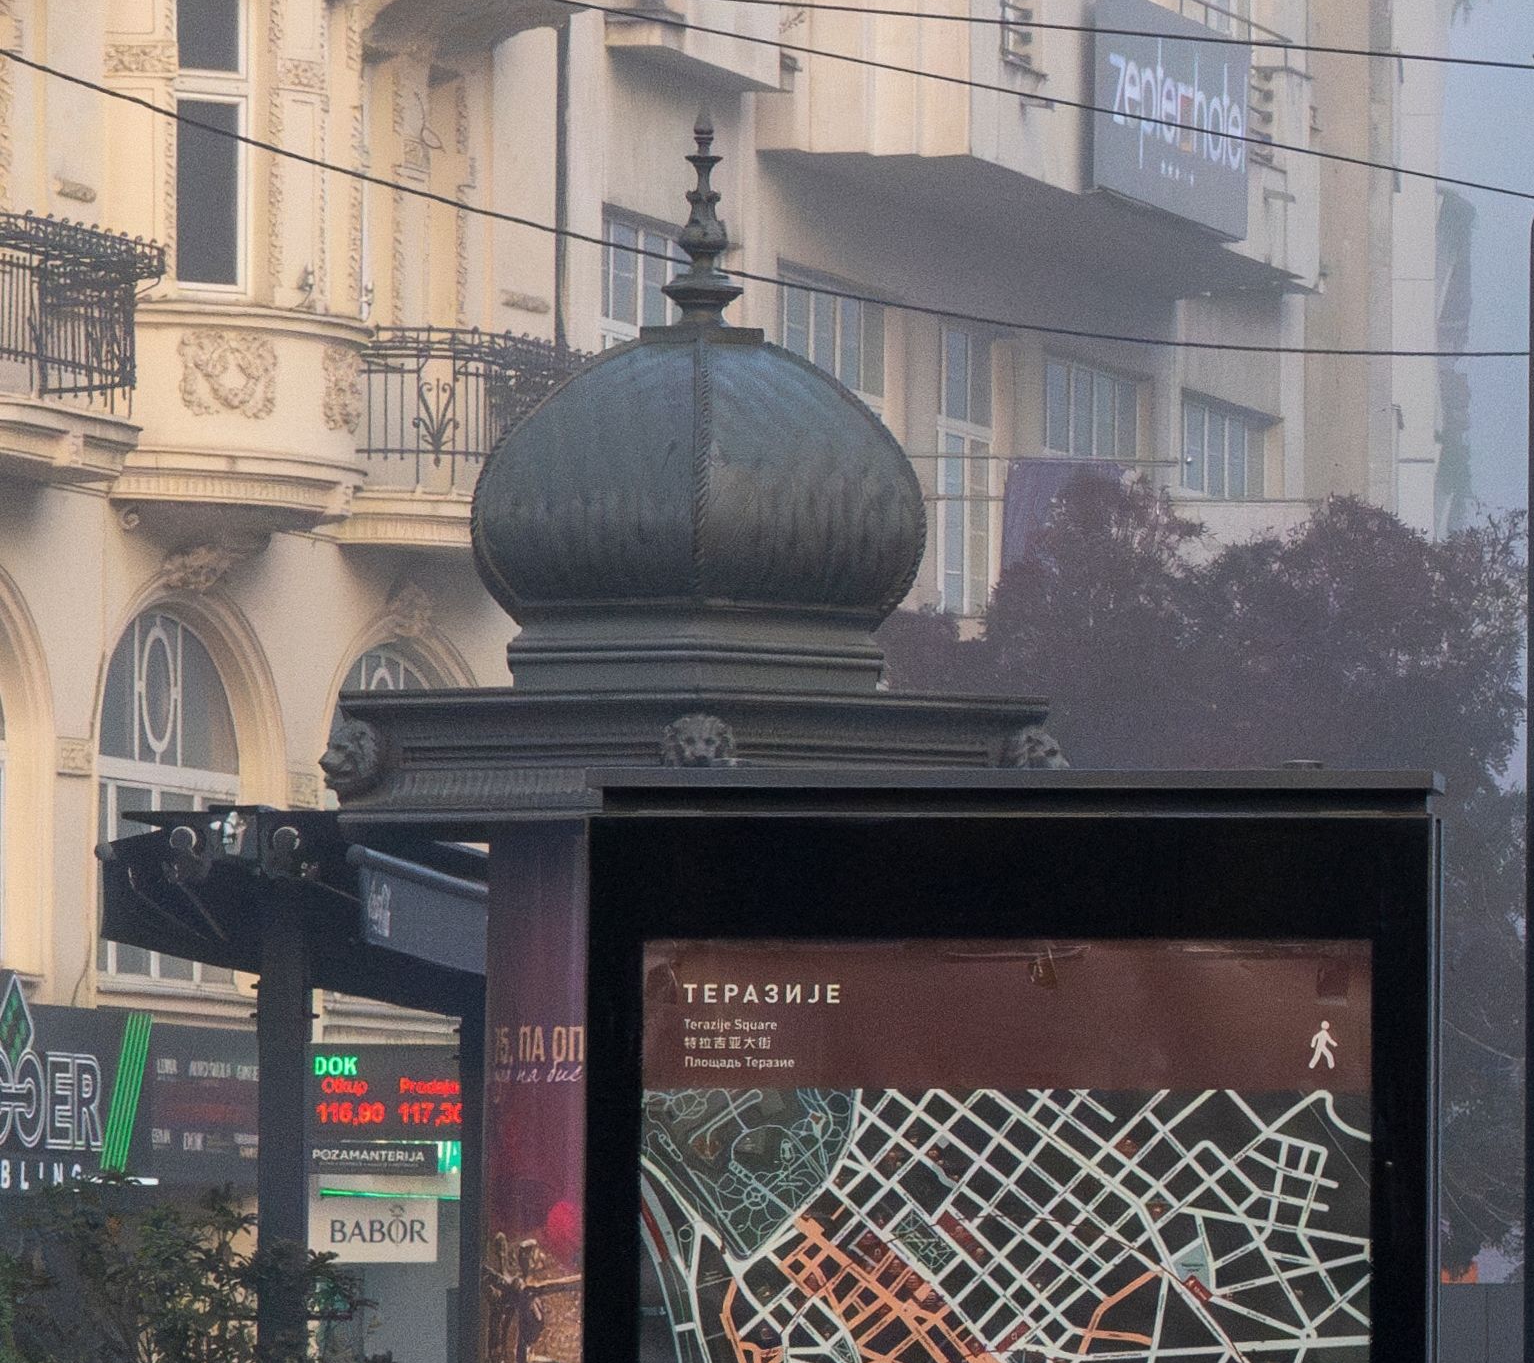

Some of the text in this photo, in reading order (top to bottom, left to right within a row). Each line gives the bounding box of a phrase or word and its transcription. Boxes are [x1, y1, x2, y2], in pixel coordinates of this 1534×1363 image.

[683, 983, 841, 1005] ТЕРАЗИЈЕ
[684, 1018, 778, 1033] Terazije Square
[685, 1055, 796, 1071] Площадь Теразие
[312, 1148, 425, 1163] POZAMANTERIJA
